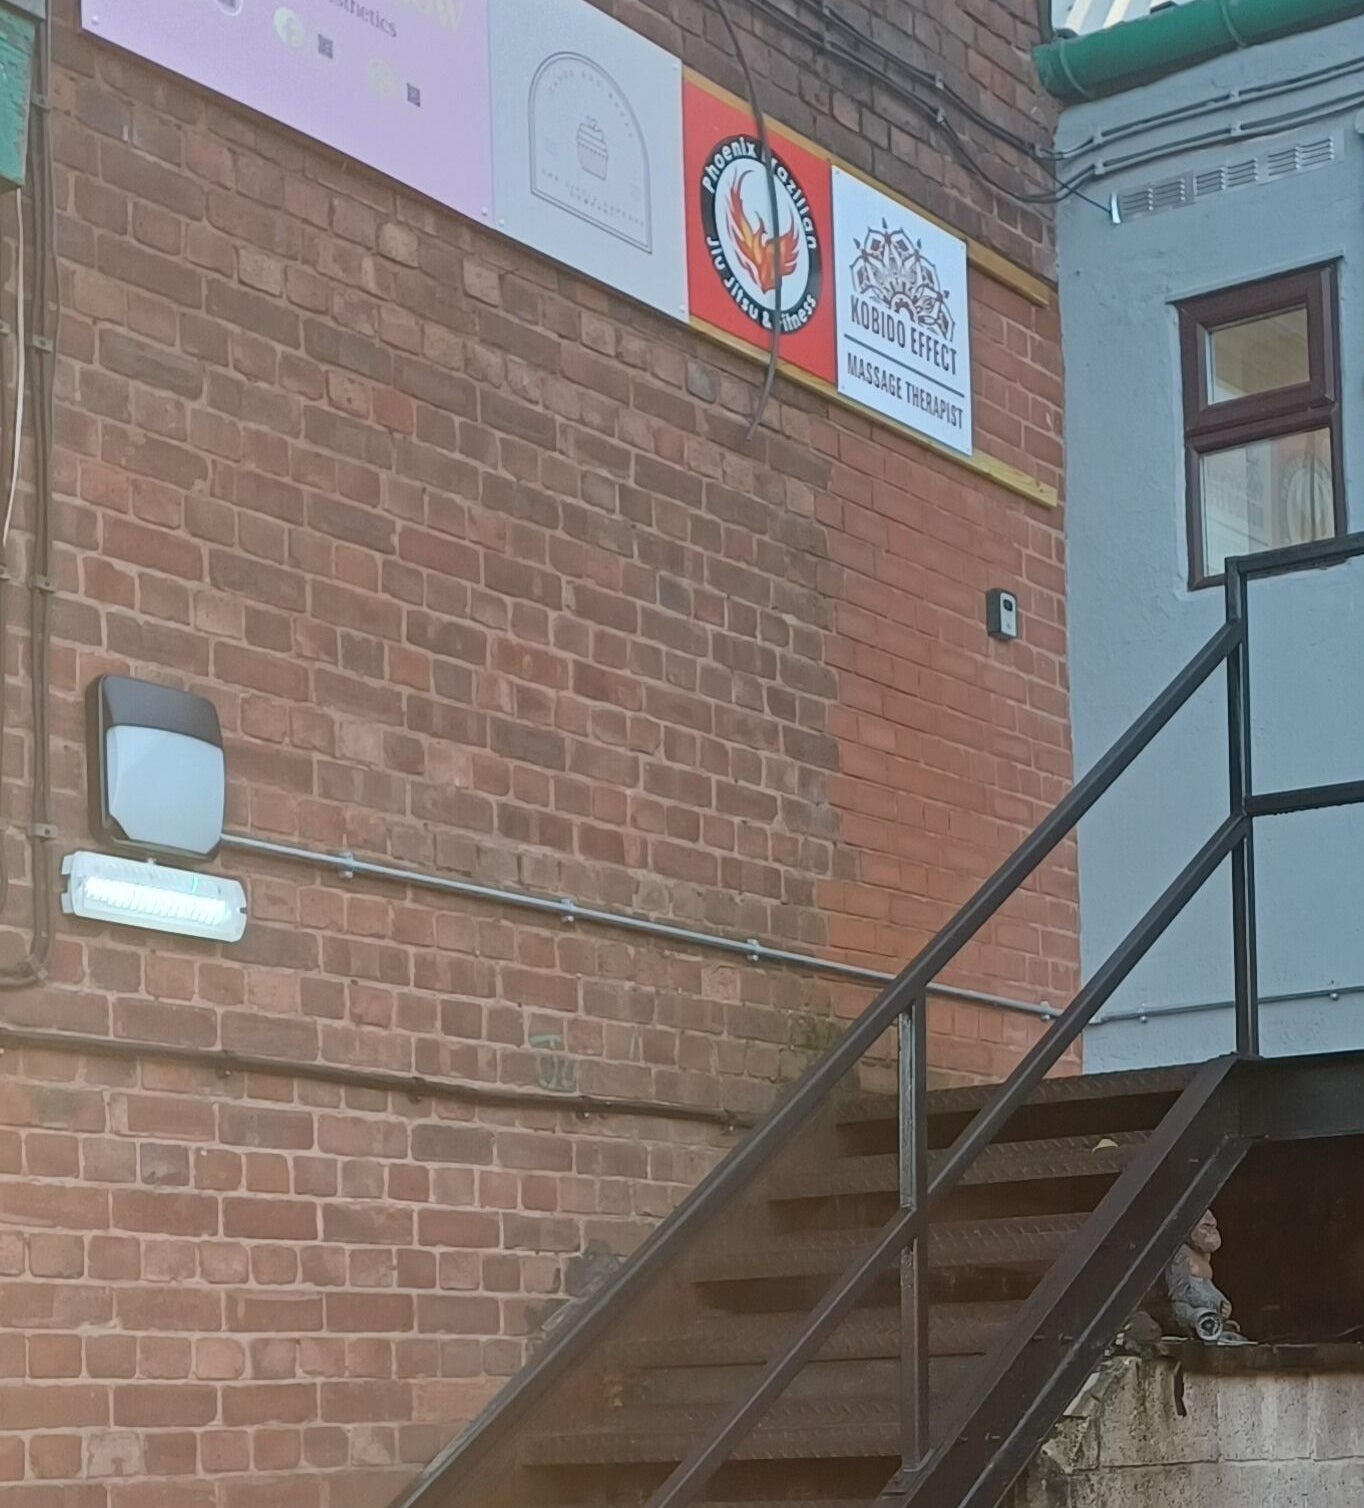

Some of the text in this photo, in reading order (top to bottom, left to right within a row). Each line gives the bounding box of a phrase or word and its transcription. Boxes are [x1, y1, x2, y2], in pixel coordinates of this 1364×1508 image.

[329, 0, 397, 38] sthetics
[702, 137, 757, 194] Phoenix
[706, 236, 726, 271] Jiu
[723, 275, 760, 320] Jitsu
[777, 294, 817, 332] itness
[850, 294, 957, 376] KOBIDO EFFECT
[847, 351, 964, 430] MASSAGE THERAPIST
